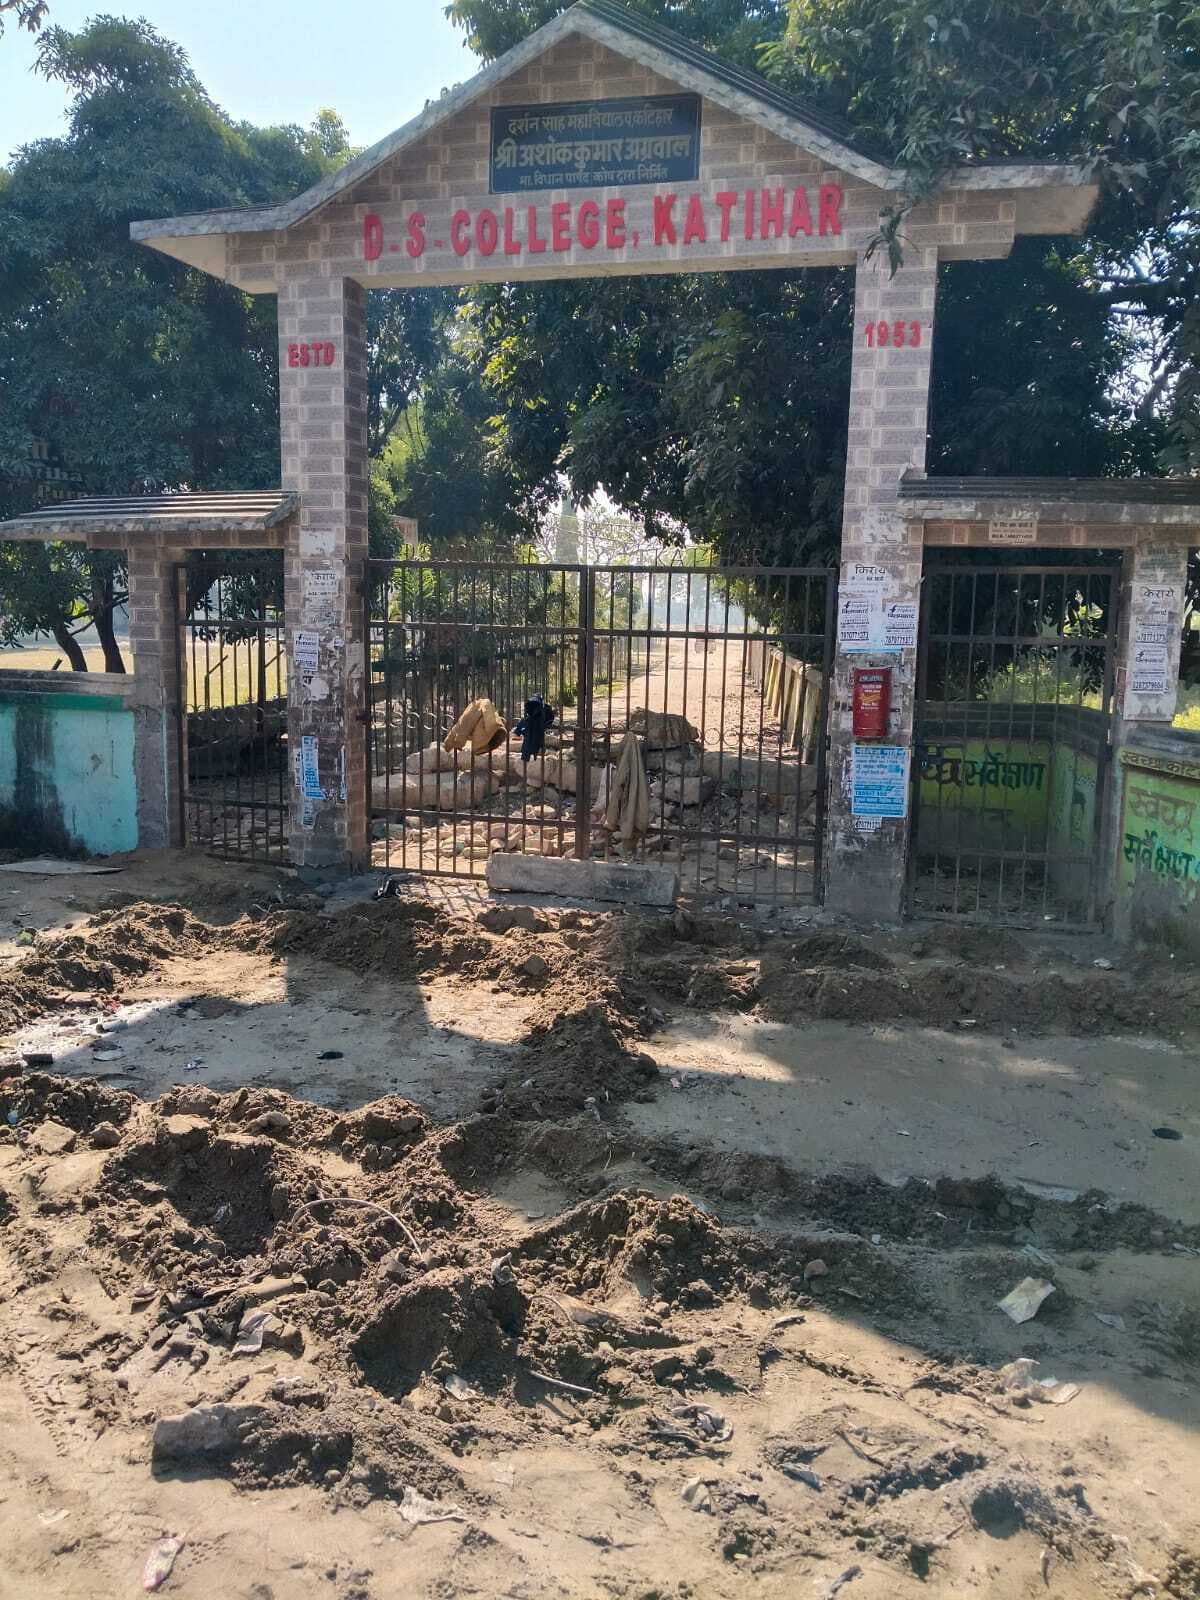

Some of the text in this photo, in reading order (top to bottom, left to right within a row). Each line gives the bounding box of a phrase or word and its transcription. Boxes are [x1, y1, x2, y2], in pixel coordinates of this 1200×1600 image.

[495, 135, 691, 170] श्री अशोक कुमार अग्रवाल
[653, 184, 842, 246] KATIHAR
[864, 320, 921, 348] 1953
[288, 342, 335, 368] ESTD
